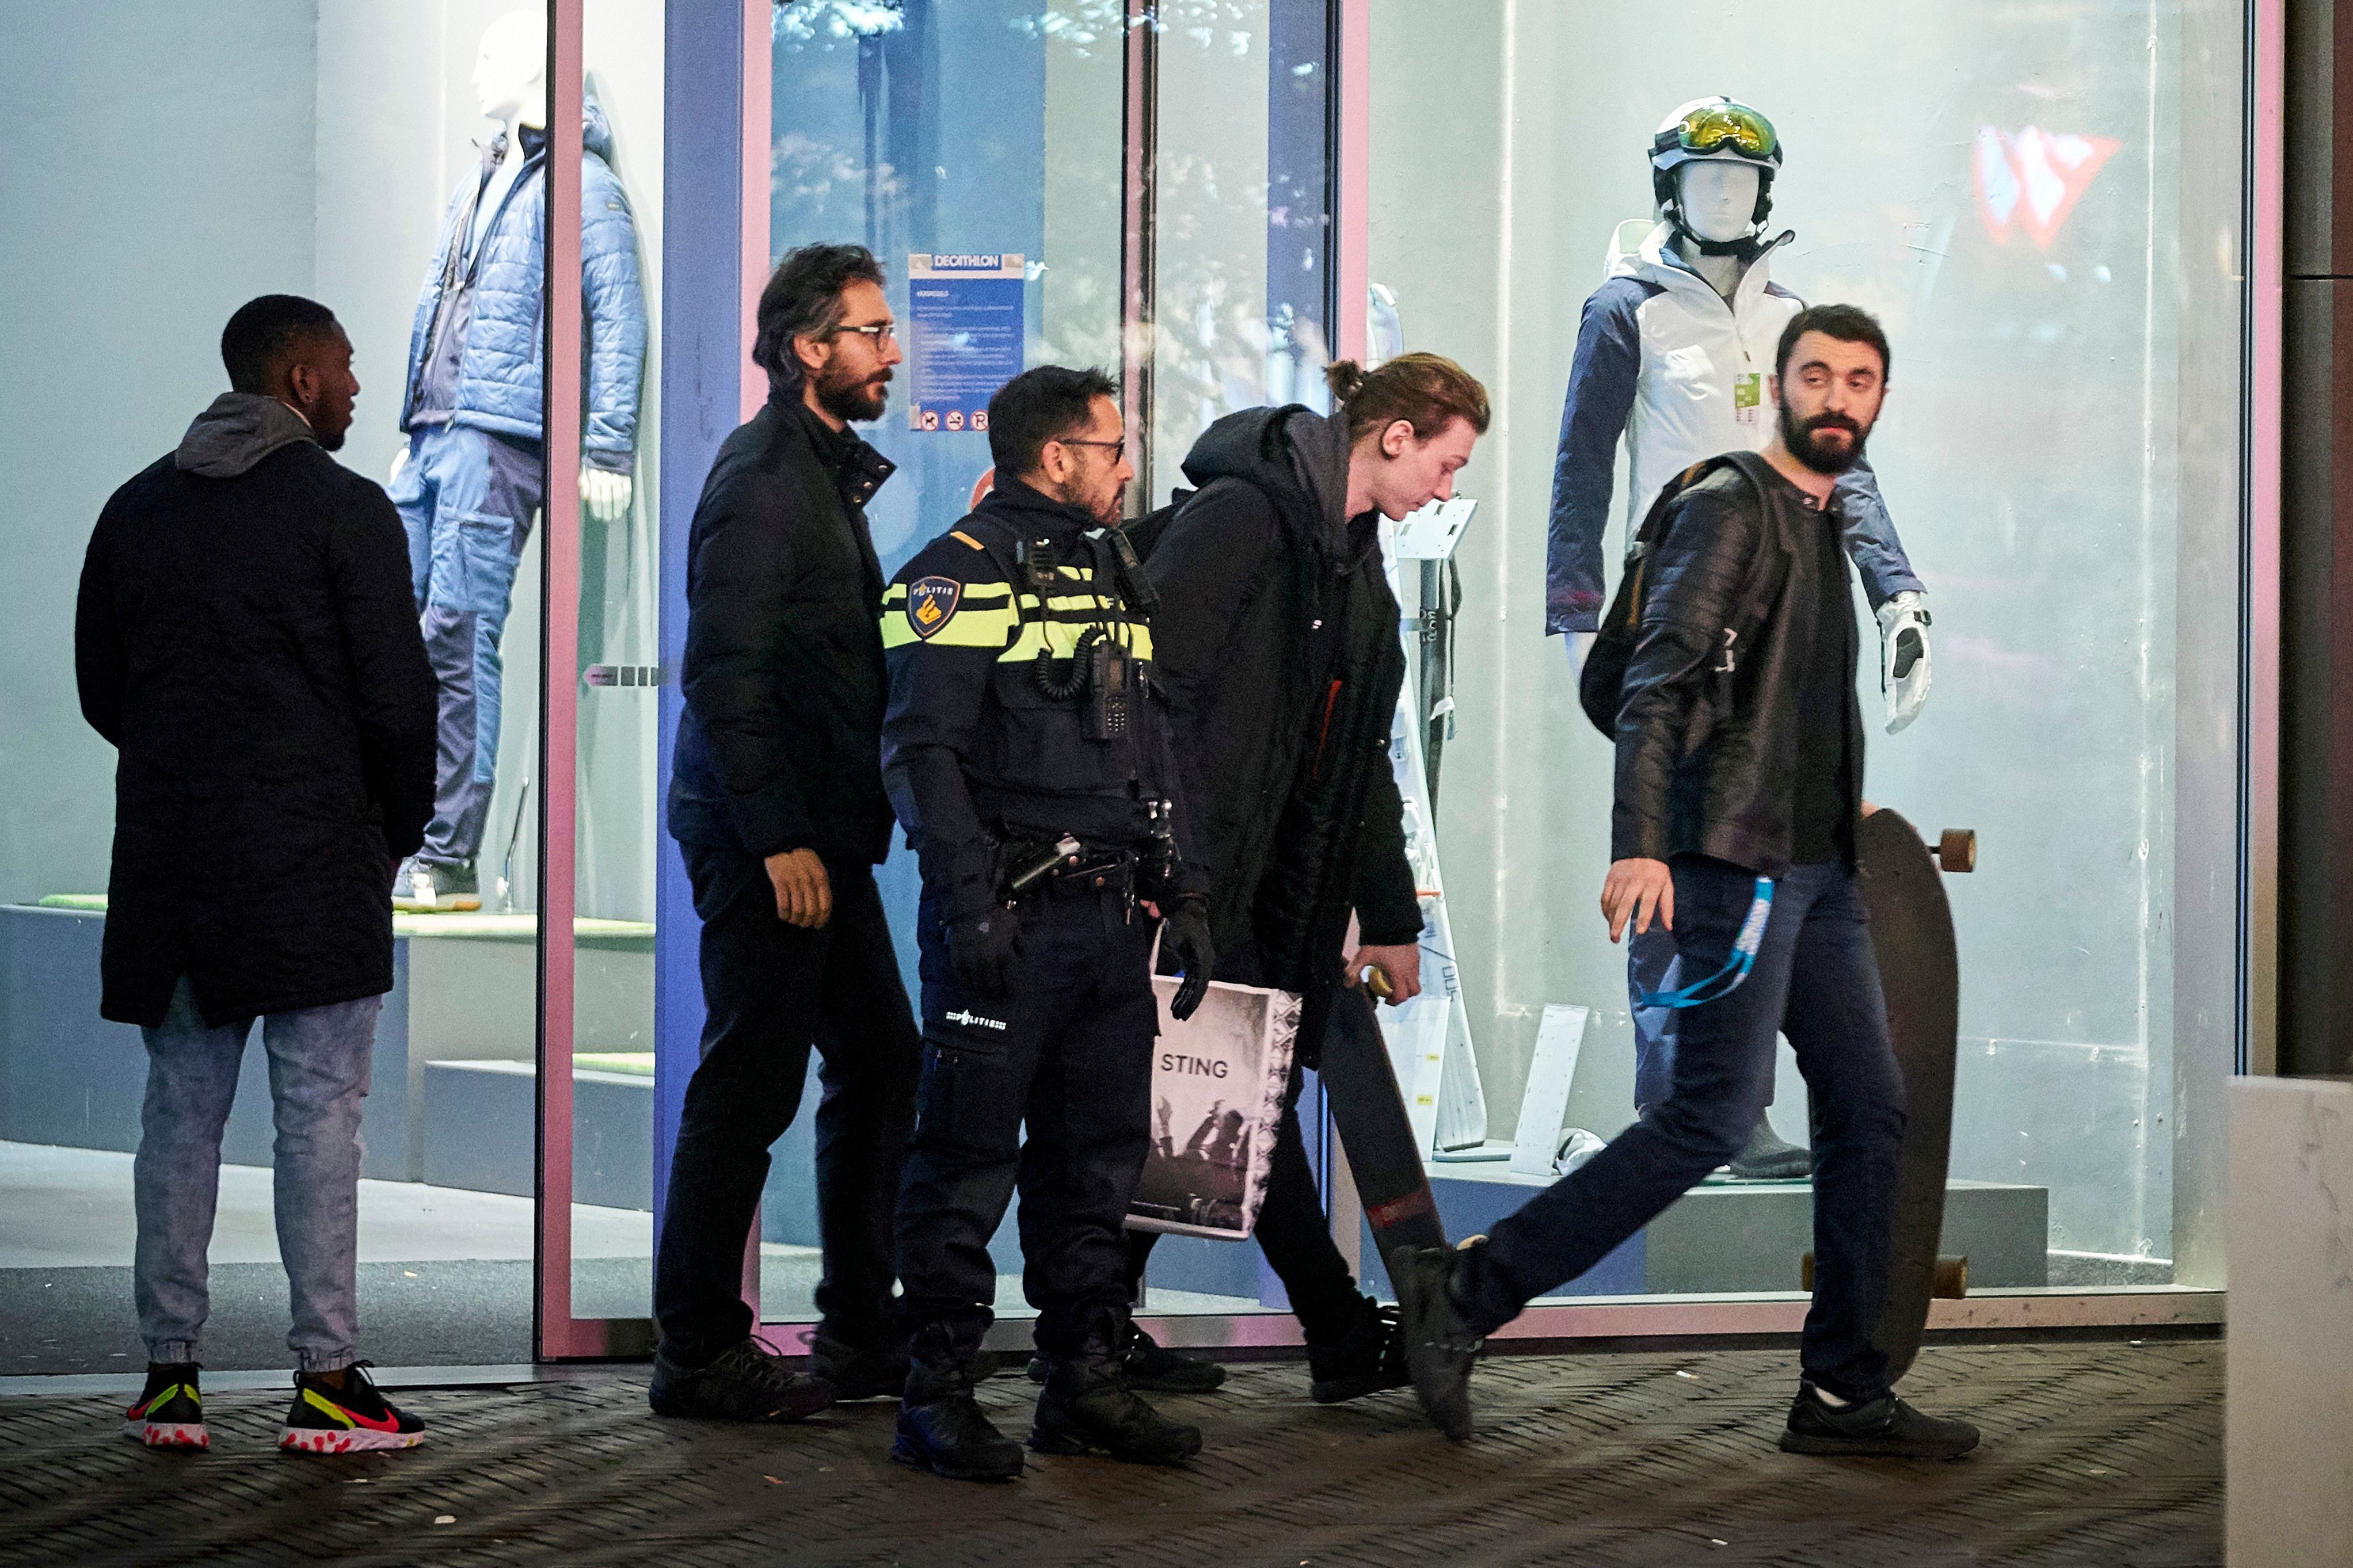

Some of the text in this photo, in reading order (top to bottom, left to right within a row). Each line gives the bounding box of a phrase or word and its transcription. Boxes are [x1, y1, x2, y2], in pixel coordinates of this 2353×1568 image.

[935, 255, 999, 267] DECATHLON
[913, 586, 953, 596] POLITIE
[956, 1011, 996, 1028] POLITIE
[1161, 1054, 1228, 1078] STING
